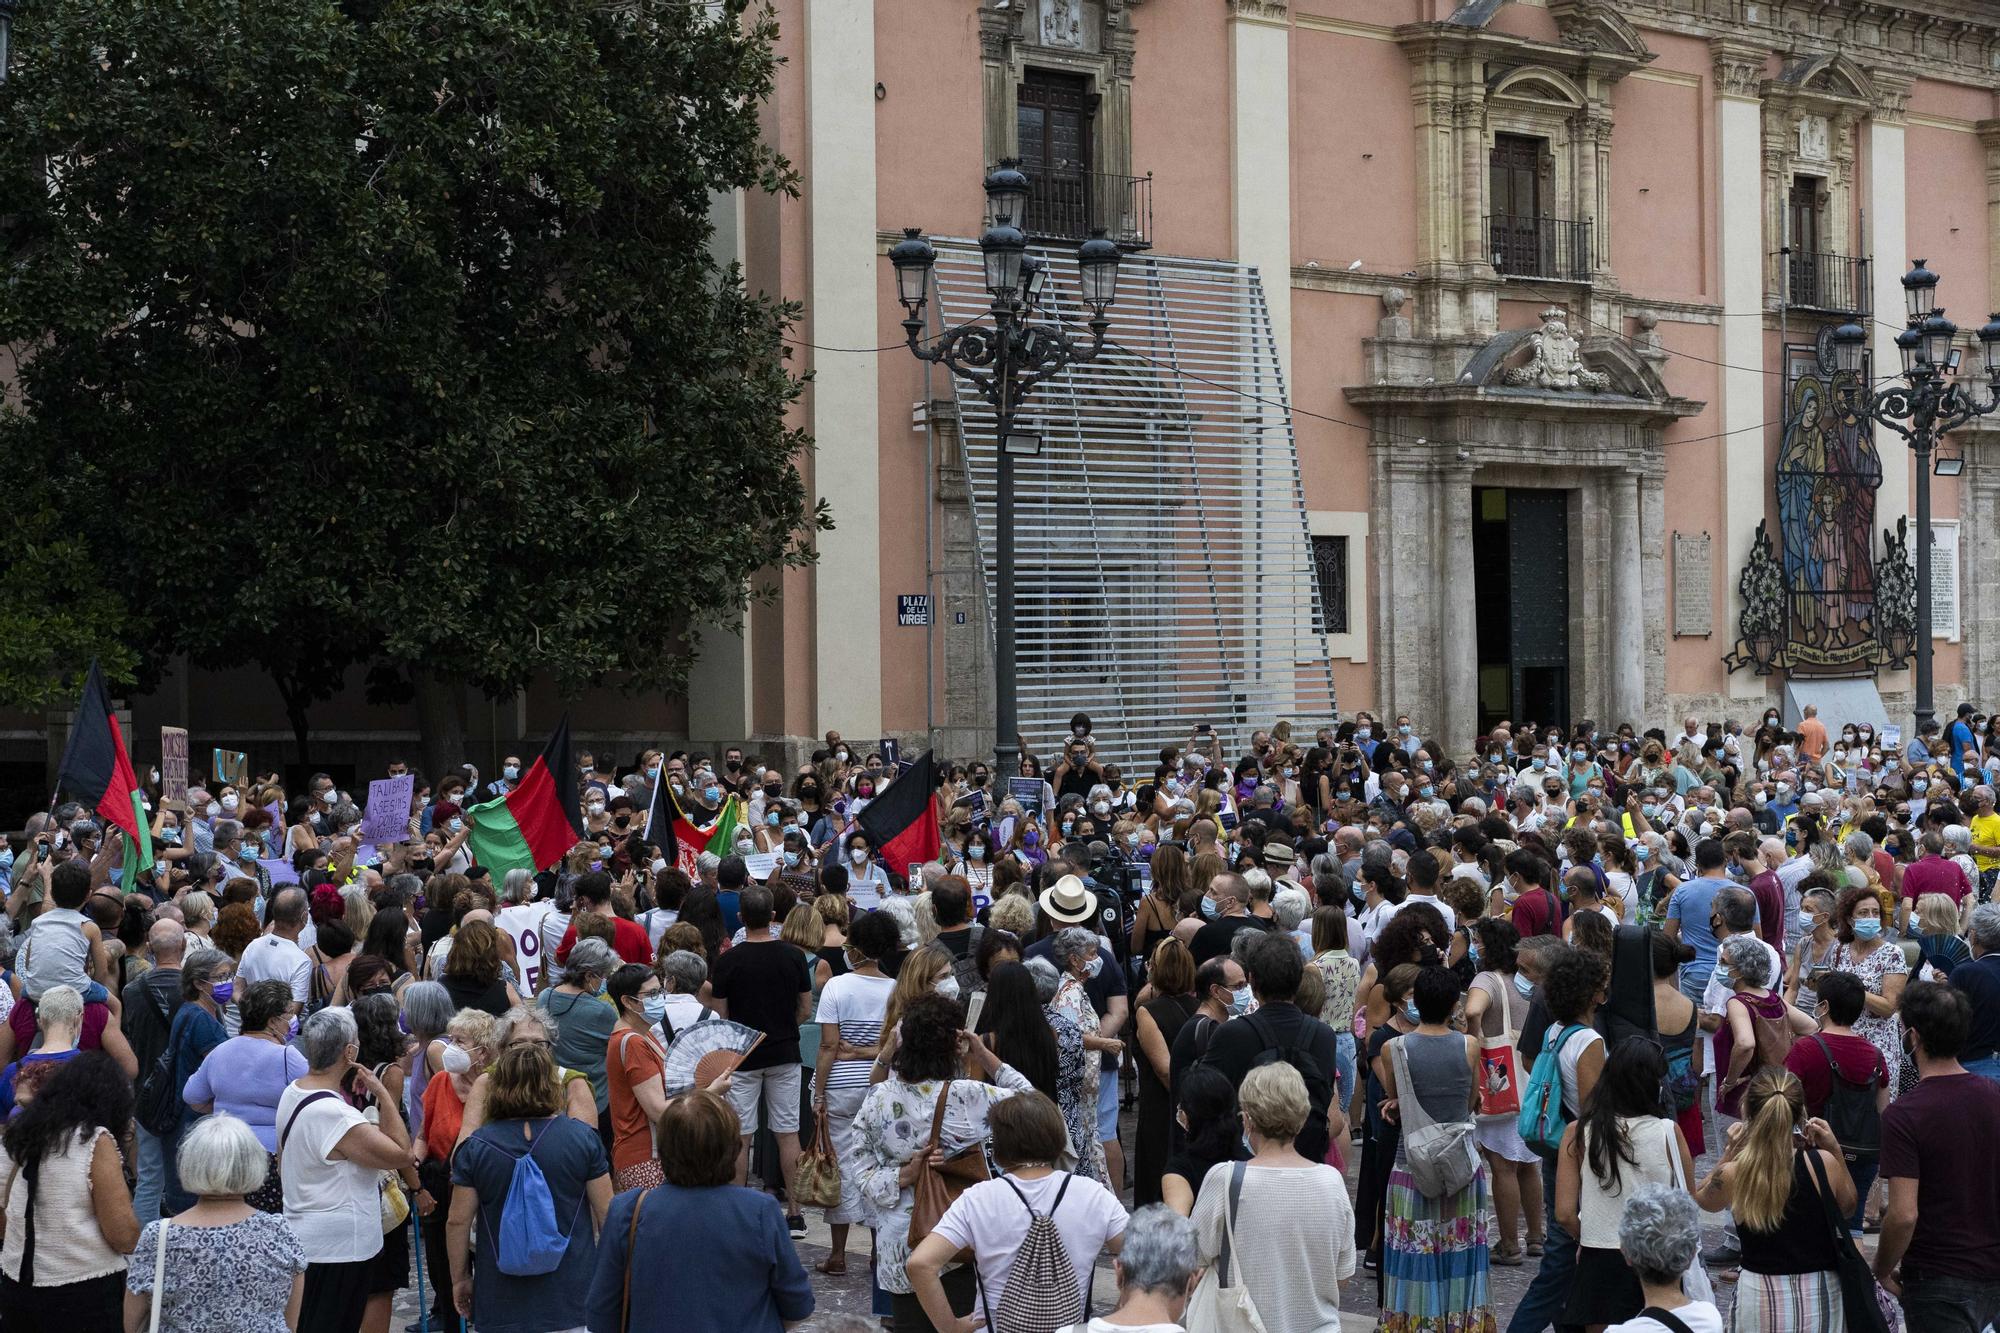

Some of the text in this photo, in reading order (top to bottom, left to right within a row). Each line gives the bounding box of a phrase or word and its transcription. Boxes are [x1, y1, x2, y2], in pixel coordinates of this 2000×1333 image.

[900, 614, 928, 625] VIRGE
[958, 613, 964, 623] 6
[373, 779, 409, 797] TALIBANS
